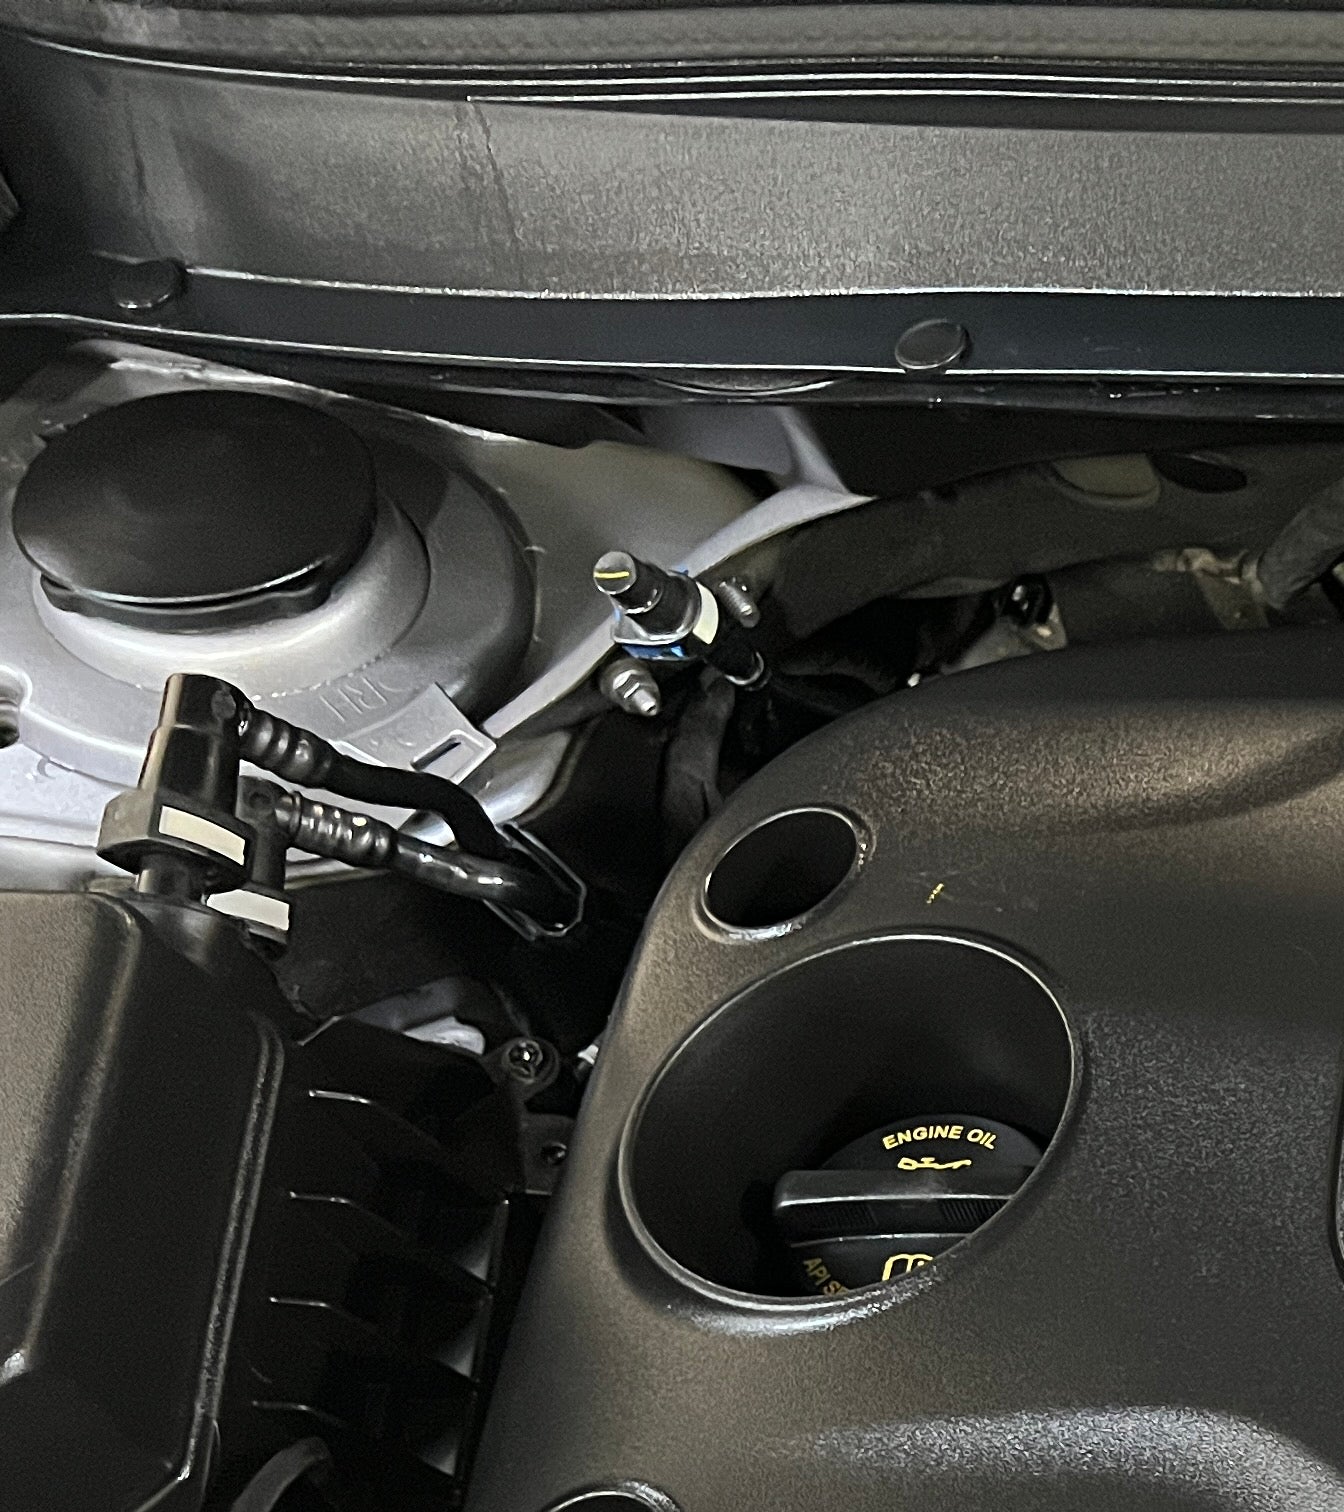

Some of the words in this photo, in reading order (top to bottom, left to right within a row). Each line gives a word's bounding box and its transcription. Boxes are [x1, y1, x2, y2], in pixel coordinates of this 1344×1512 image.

[882, 1125, 964, 1150] ENGINE
[966, 1128, 999, 1150] OIL
[803, 1256, 827, 1287] API
